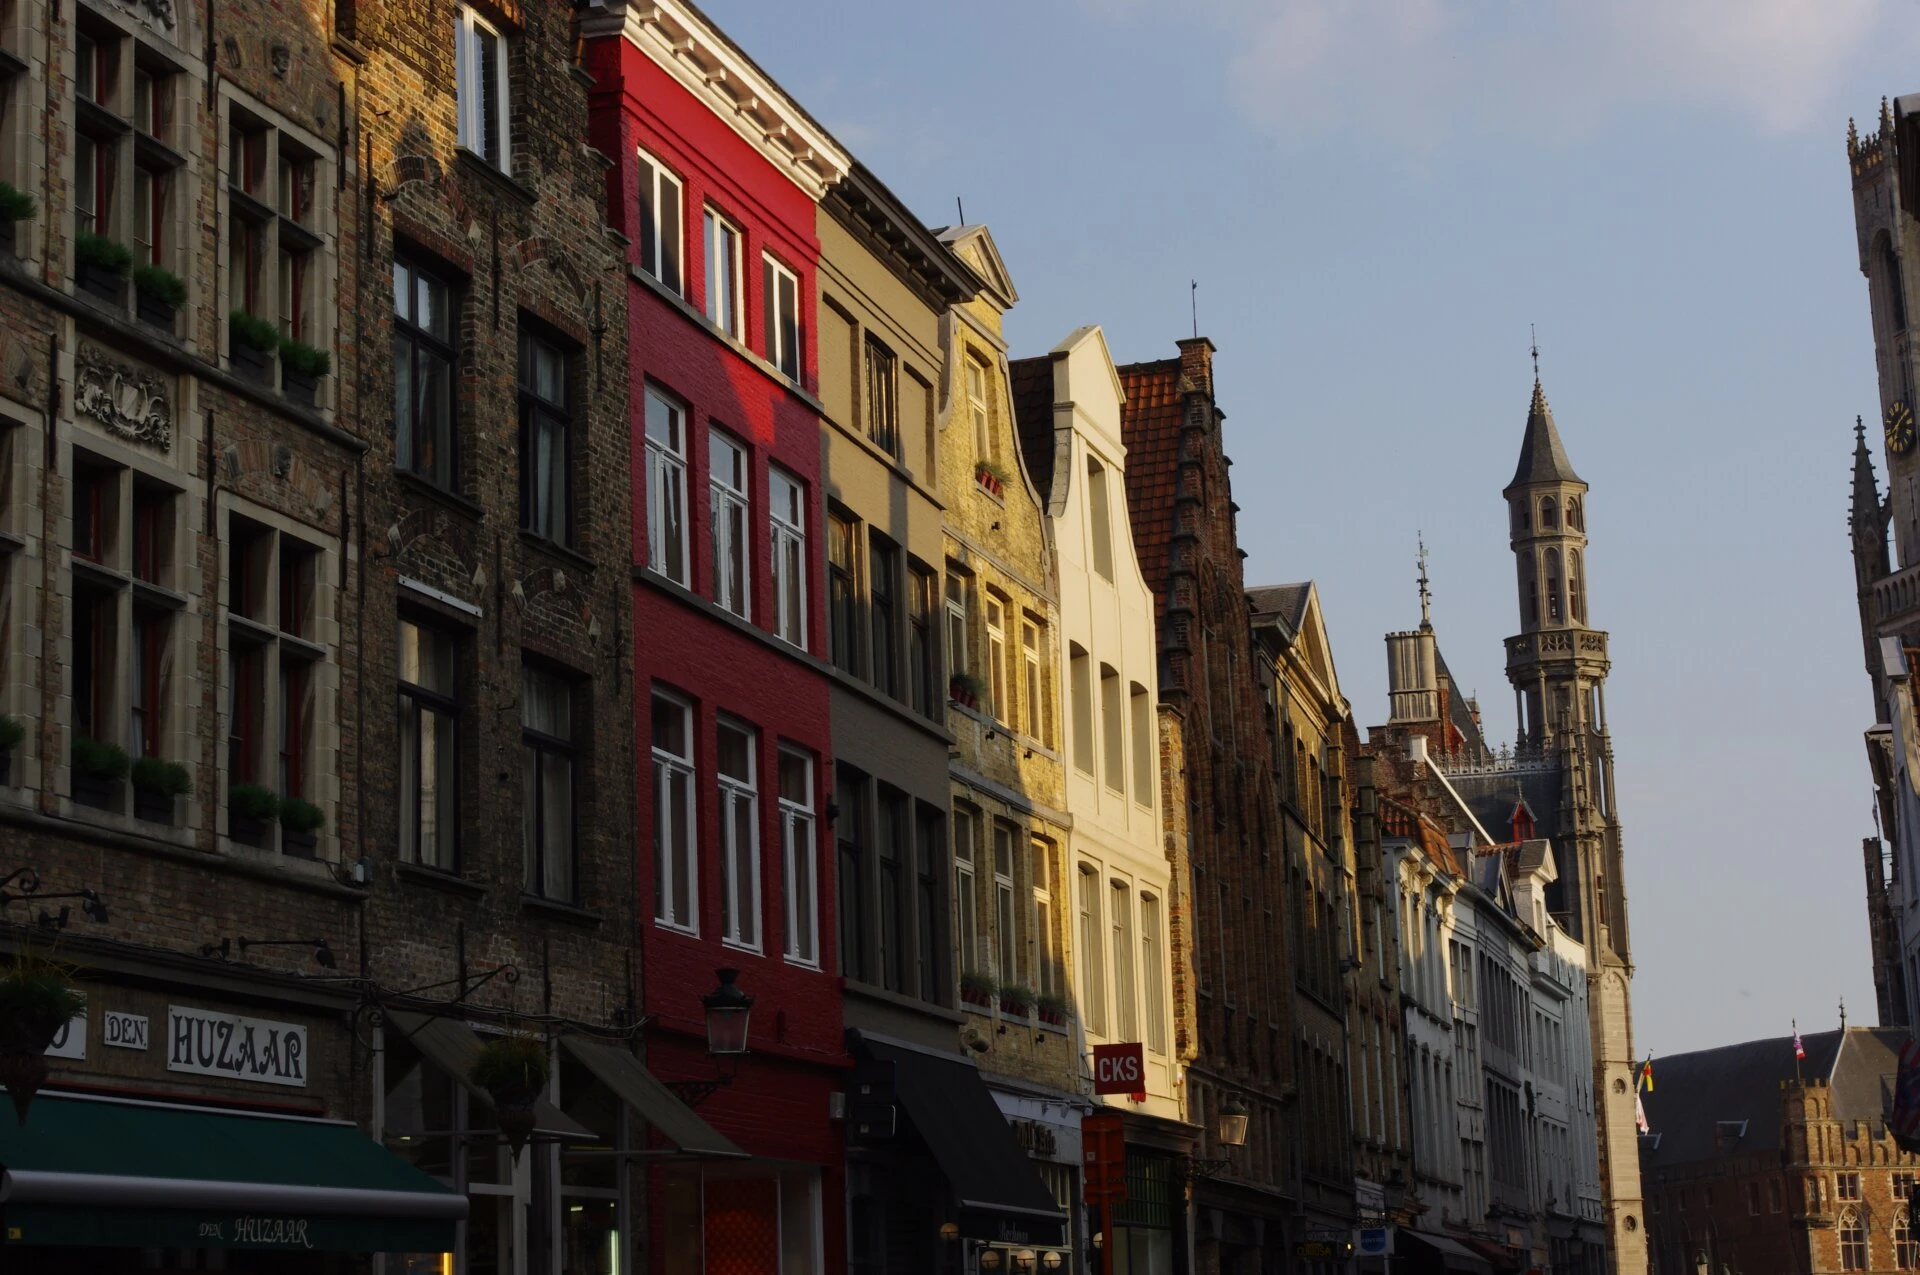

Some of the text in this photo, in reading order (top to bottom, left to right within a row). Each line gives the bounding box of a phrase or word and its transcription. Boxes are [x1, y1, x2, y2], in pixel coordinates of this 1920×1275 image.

[109, 1016, 146, 1044] DEN
[172, 1015, 303, 1079] HUZAAR
[1099, 1056, 1138, 1083] CKS
[199, 1217, 314, 1248] DEN HUZAAR
